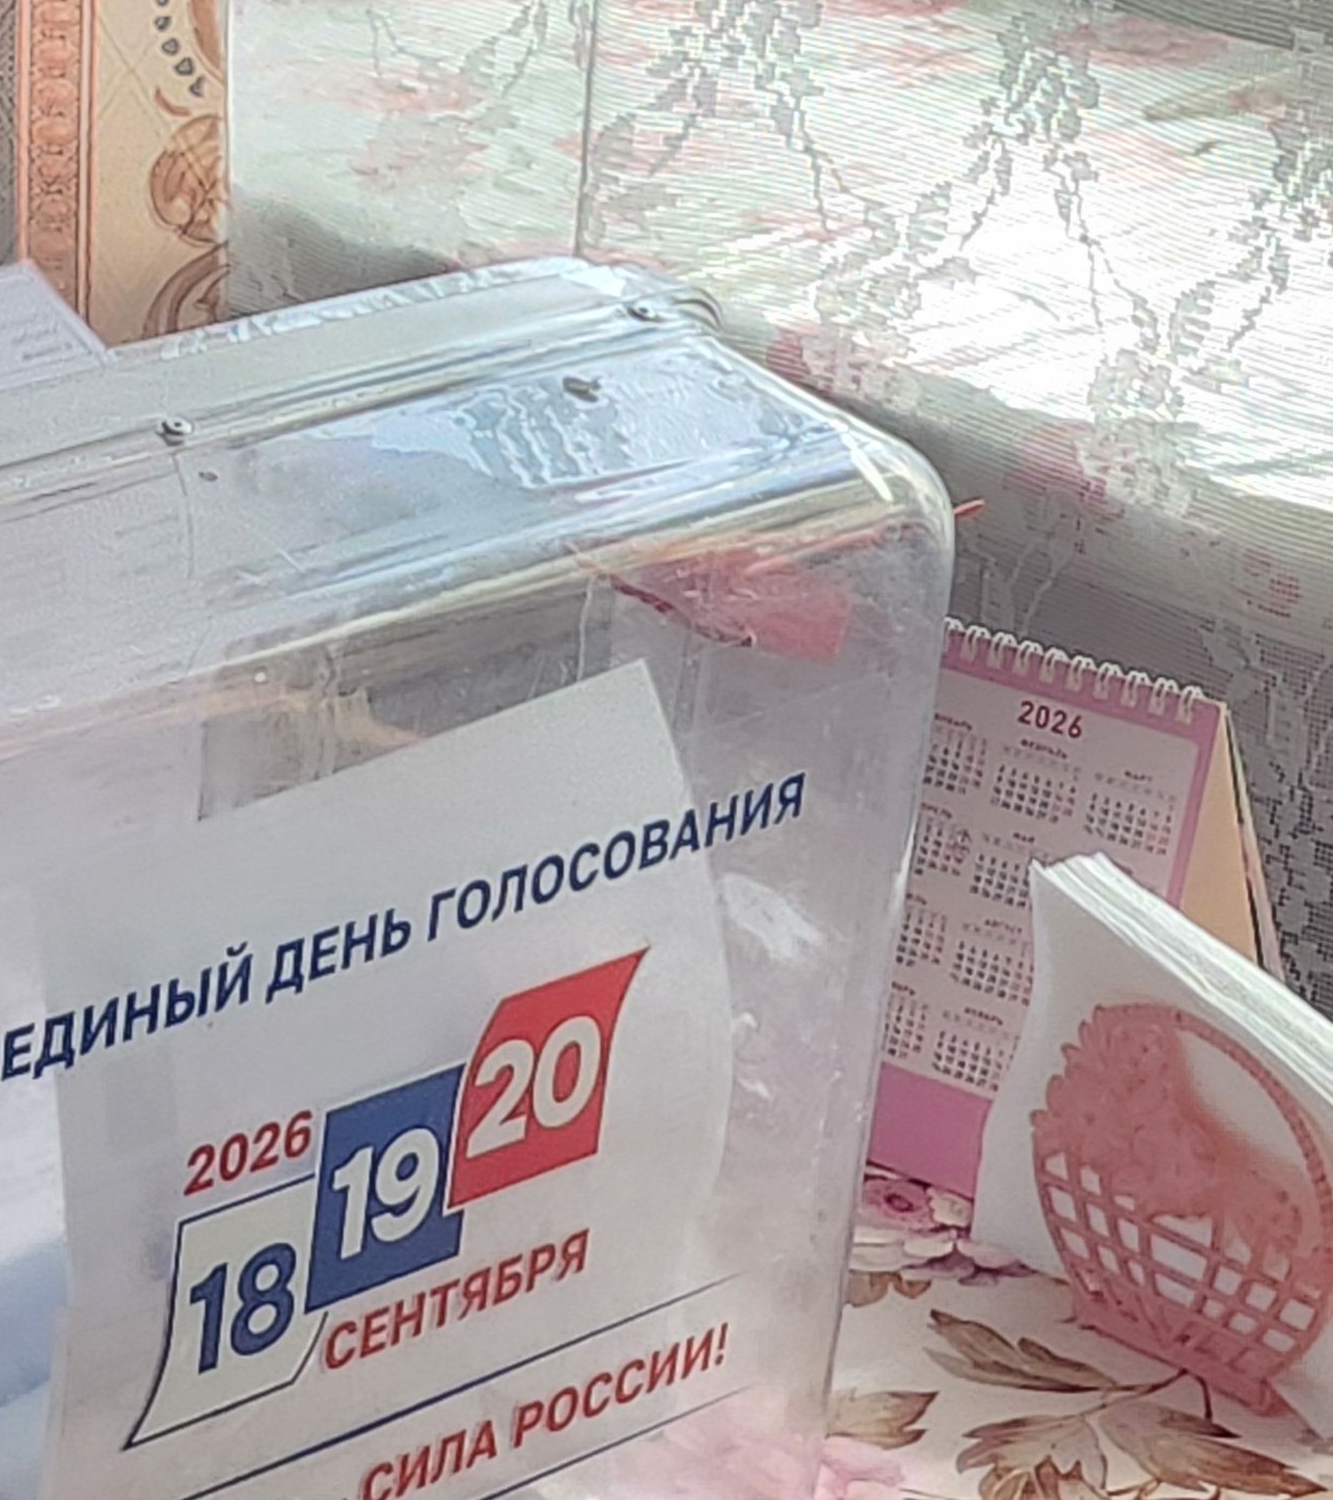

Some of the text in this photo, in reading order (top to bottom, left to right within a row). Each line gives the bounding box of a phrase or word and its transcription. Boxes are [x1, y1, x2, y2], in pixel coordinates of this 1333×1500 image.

[1017, 700, 1083, 739] 2026
[0, 943, 254, 1081] ЕДИНЫЙ
[265, 908, 412, 1002] ДЕНЬ
[427, 772, 806, 941] ГОЛОСОВАНИЯ
[183, 1110, 313, 1196] 2026
[188, 1015, 603, 1374] 18 19 20
[325, 1229, 589, 1369] СЕНТЯБРЯ
[358, 1322, 729, 1500] СИЛА РОССИИ!
